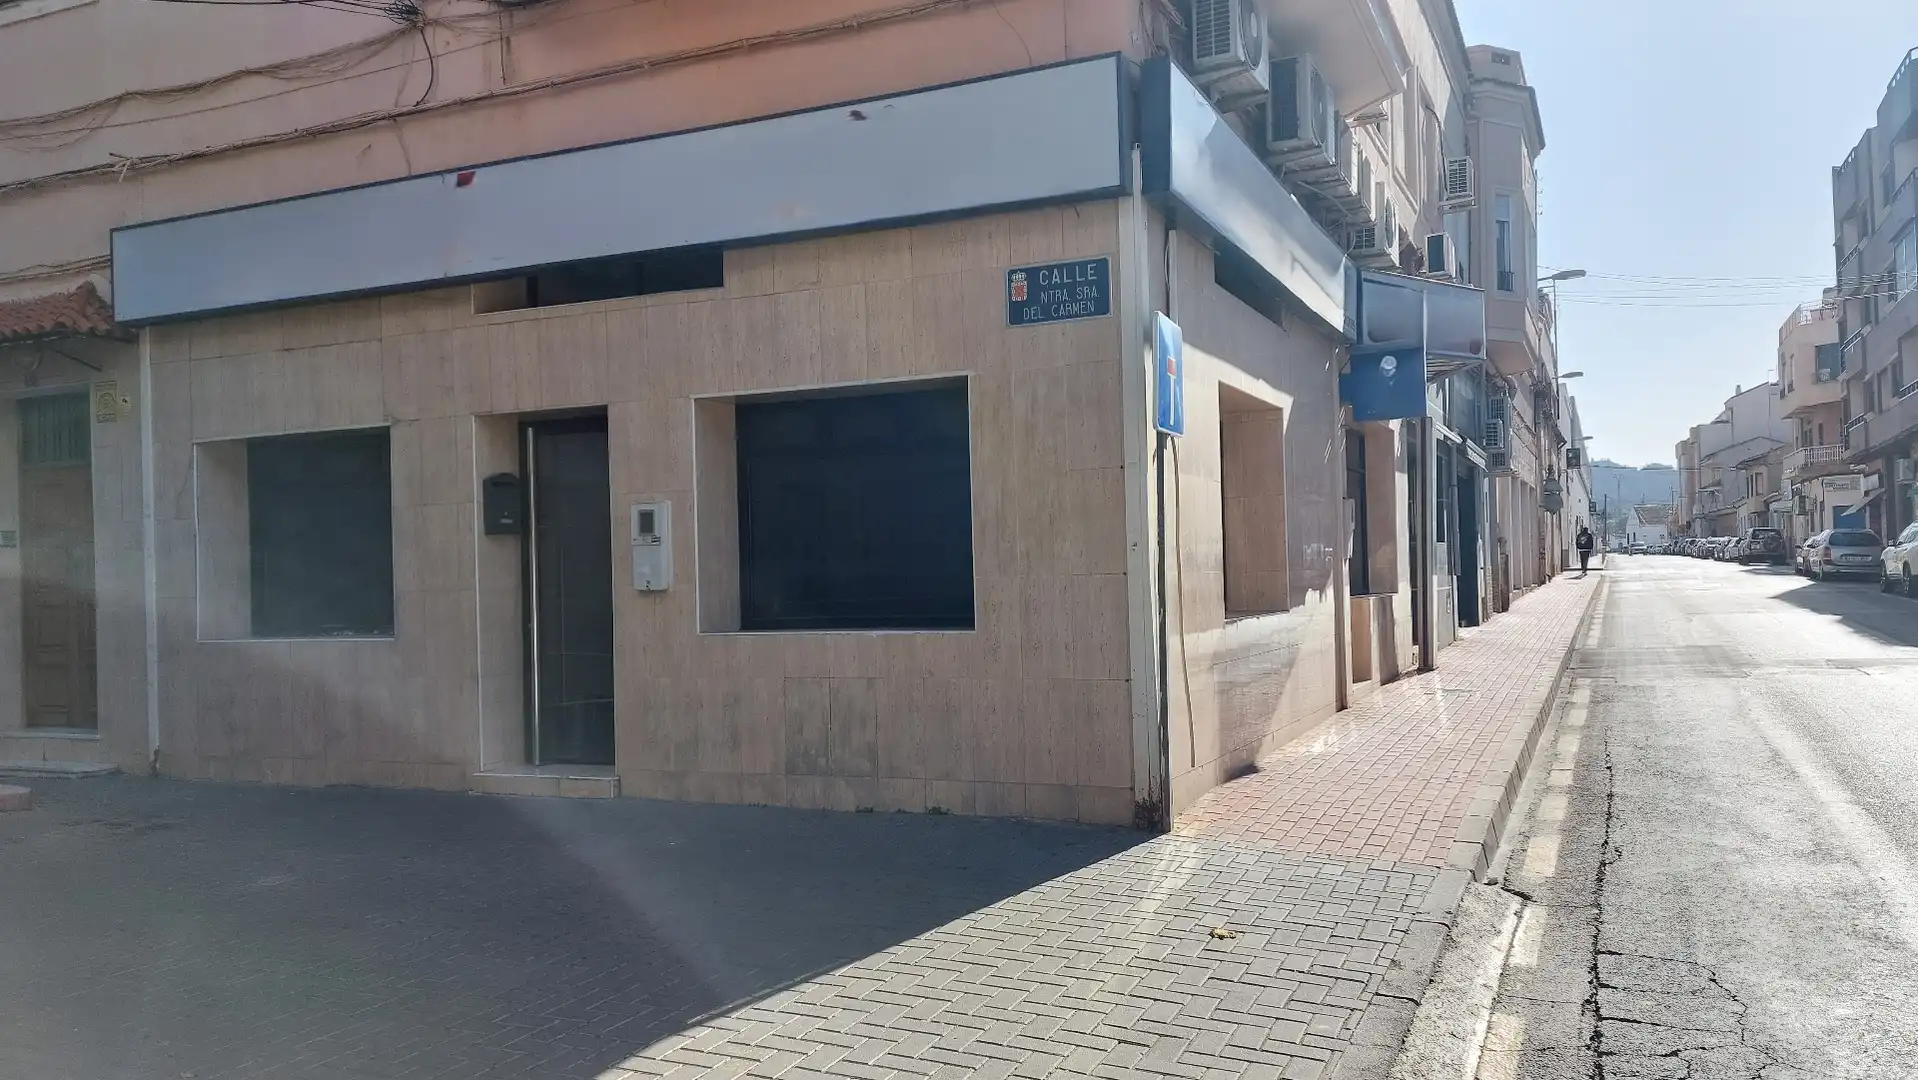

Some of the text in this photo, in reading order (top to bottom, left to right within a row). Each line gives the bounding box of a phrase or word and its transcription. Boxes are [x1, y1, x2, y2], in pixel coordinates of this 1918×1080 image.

[1039, 263, 1097, 285] CALLE
[1041, 285, 1100, 304] NTRA. SRA.
[1023, 301, 1095, 320] DEL CARMEN
